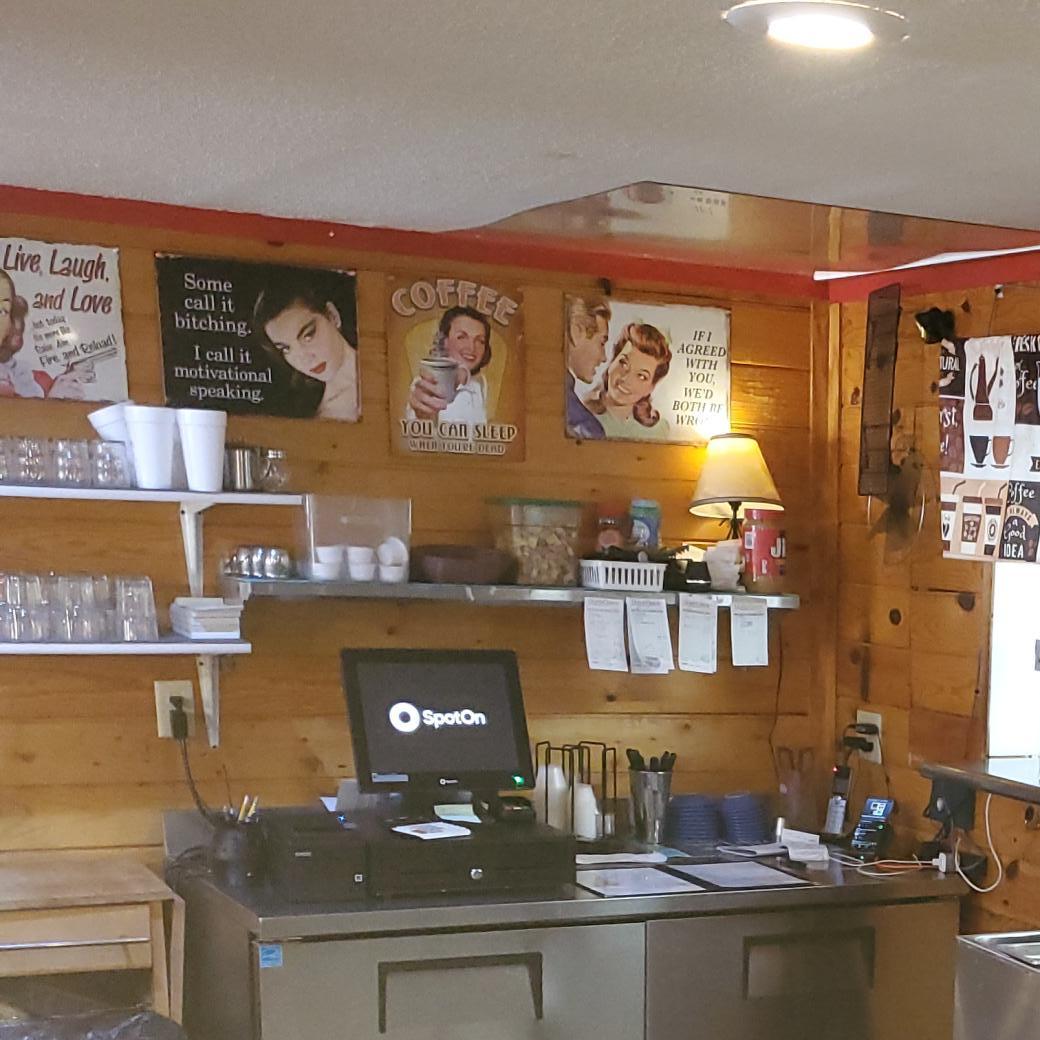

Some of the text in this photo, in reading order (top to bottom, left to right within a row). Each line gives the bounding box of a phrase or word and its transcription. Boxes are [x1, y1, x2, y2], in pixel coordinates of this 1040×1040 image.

[184, 273, 232, 292] Some
[32, 285, 113, 315] and Love
[184, 294, 235, 313] call it
[391, 279, 519, 327] COFFEE
[174, 311, 252, 338] bitching.
[692, 330, 712, 342] IF I
[194, 345, 251, 364] I call it
[677, 344, 726, 358] AGREED
[174, 363, 273, 384] motivational
[685, 357, 718, 371] WITH
[688, 372, 716, 385] YOU,
[189, 382, 265, 404] speaking.
[683, 387, 714, 400] WE'D
[401, 420, 516, 441] YOU CAN SLEEP
[770, 537, 786, 559] JI
[1003, 543, 1024, 559] IDEA
[422, 708, 486, 729] SpotOn
